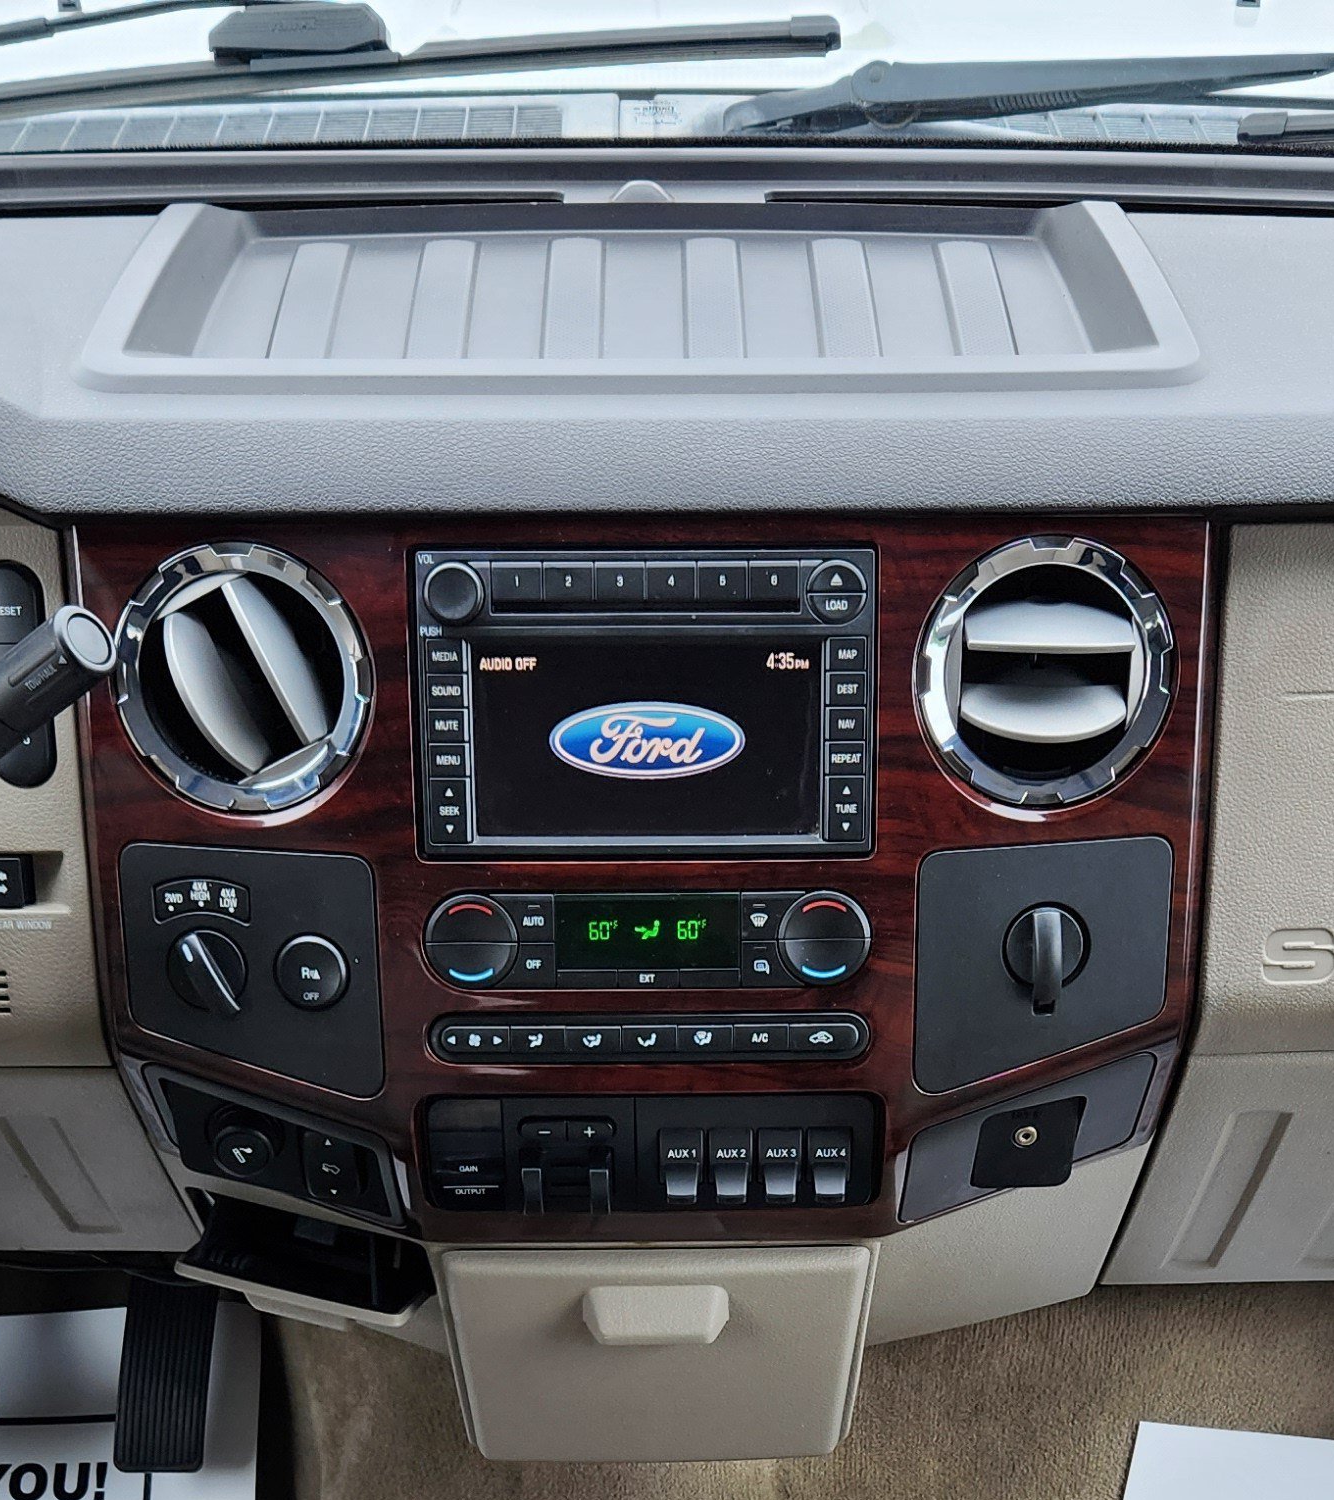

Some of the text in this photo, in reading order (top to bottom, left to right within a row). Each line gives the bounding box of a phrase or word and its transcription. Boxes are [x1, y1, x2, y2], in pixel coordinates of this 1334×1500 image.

[417, 553, 435, 565] VOL
[564, 575, 572, 587] 2
[616, 575, 624, 587] 3
[667, 575, 675, 587] 4
[825, 599, 848, 611] LOAD
[419, 626, 443, 637] PUSH
[431, 650, 459, 662] MEDIA
[838, 648, 858, 660] MAP
[479, 656, 537, 671] AUDIO OFF
[431, 685, 461, 697] SOUND
[836, 683, 859, 695] DEST
[434, 719, 459, 731] MUTE
[838, 718, 856, 730] NAV
[588, 714, 704, 765] Ford
[435, 754, 461, 766] MENU
[830, 752, 861, 764] REPEAT
[438, 805, 460, 817] SEEK
[835, 803, 858, 815] TUNE
[164, 892, 184, 903] 2WD
[16, 920, 53, 930] WINDOW
[522, 915, 545, 927] AUTO
[525, 958, 542, 970] OFF
[639, 974, 655, 984] EXT
[303, 992, 320, 1001] OFF
[751, 1032, 769, 1044] A/C
[667, 1148, 689, 1159] AUX
[716, 1148, 738, 1159] AUX
[766, 1148, 788, 1159] AUX
[815, 1148, 837, 1159] AUX
[459, 1164, 478, 1174] GAIN
[455, 1187, 486, 1196] OUTPUT
